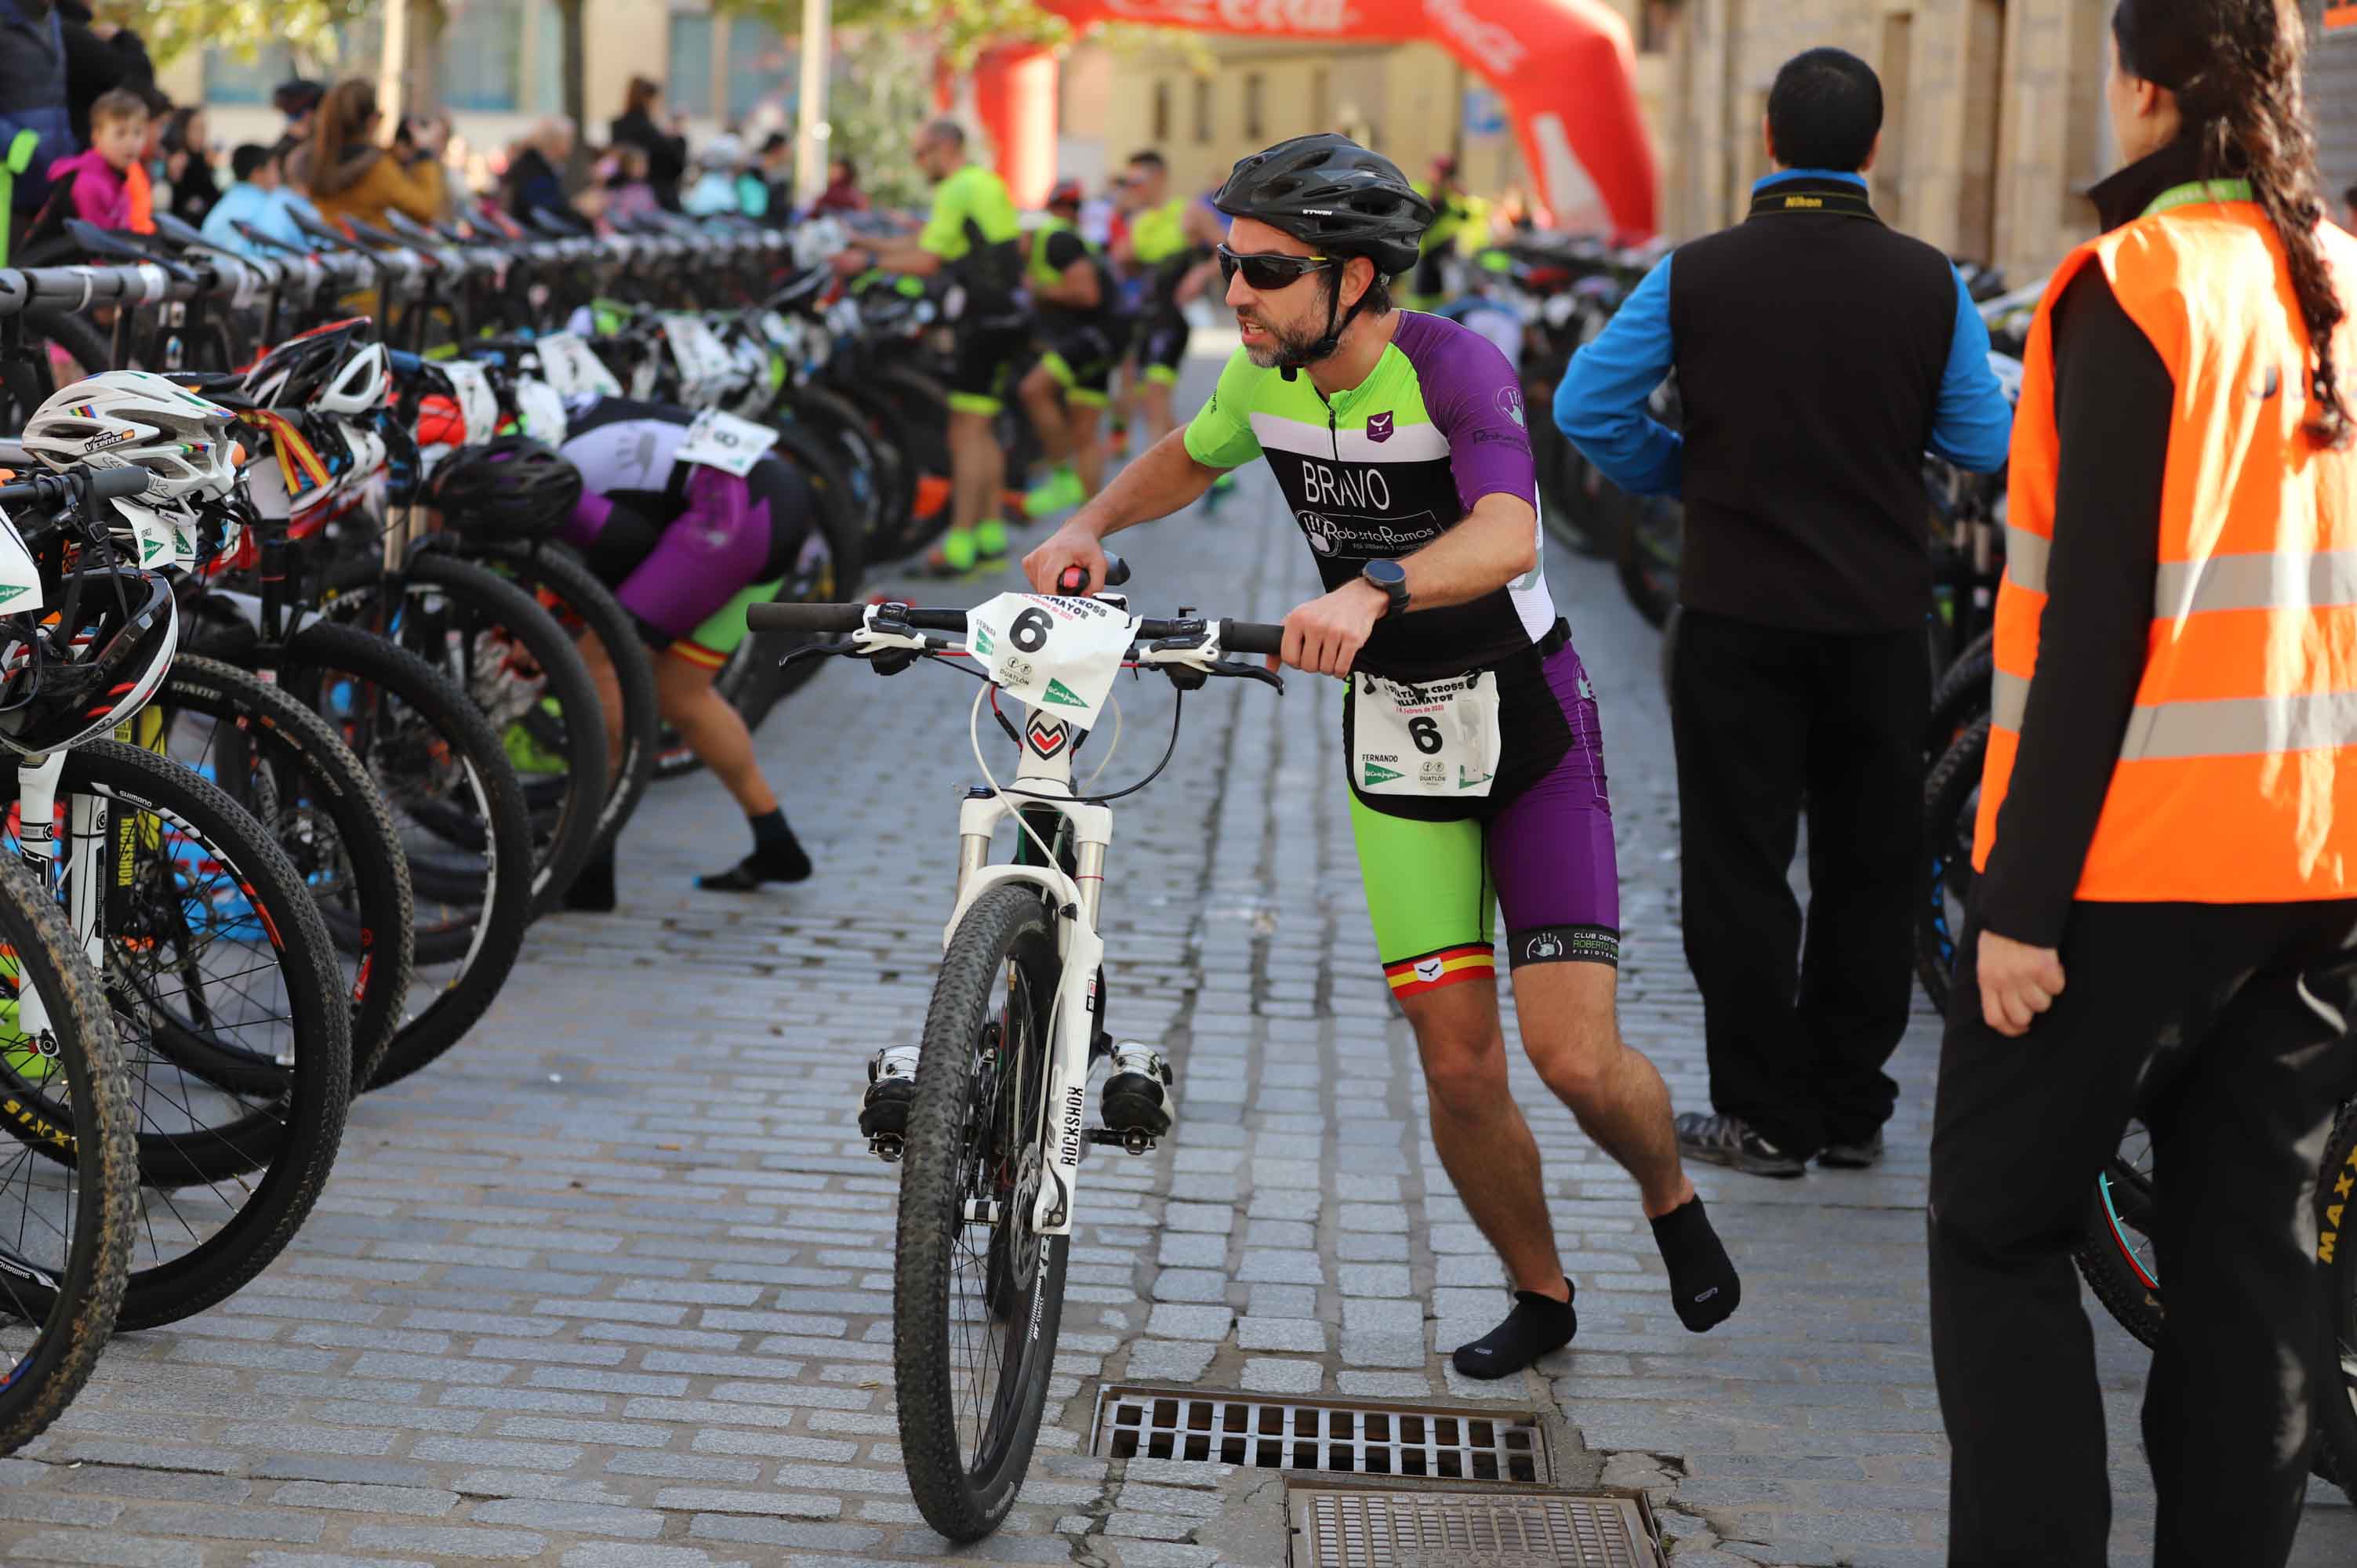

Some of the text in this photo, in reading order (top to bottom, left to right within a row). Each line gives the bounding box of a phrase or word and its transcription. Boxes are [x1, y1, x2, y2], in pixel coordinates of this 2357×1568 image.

[1785, 194, 1822, 208] Nikon
[85, 435, 122, 451] Vicente
[1302, 460, 1390, 510] BRAVO
[1009, 607, 1054, 653] 6
[1431, 681, 1465, 693] CROSS
[1408, 716, 1443, 755] 6
[1362, 753, 1399, 763] FERNANDO
[119, 790, 152, 808] SHIMANO
[118, 817, 136, 887] ROCKSHOX
[1573, 940, 1609, 951] ROBERTO
[1059, 1086, 1084, 1167] ROCKSHOX
